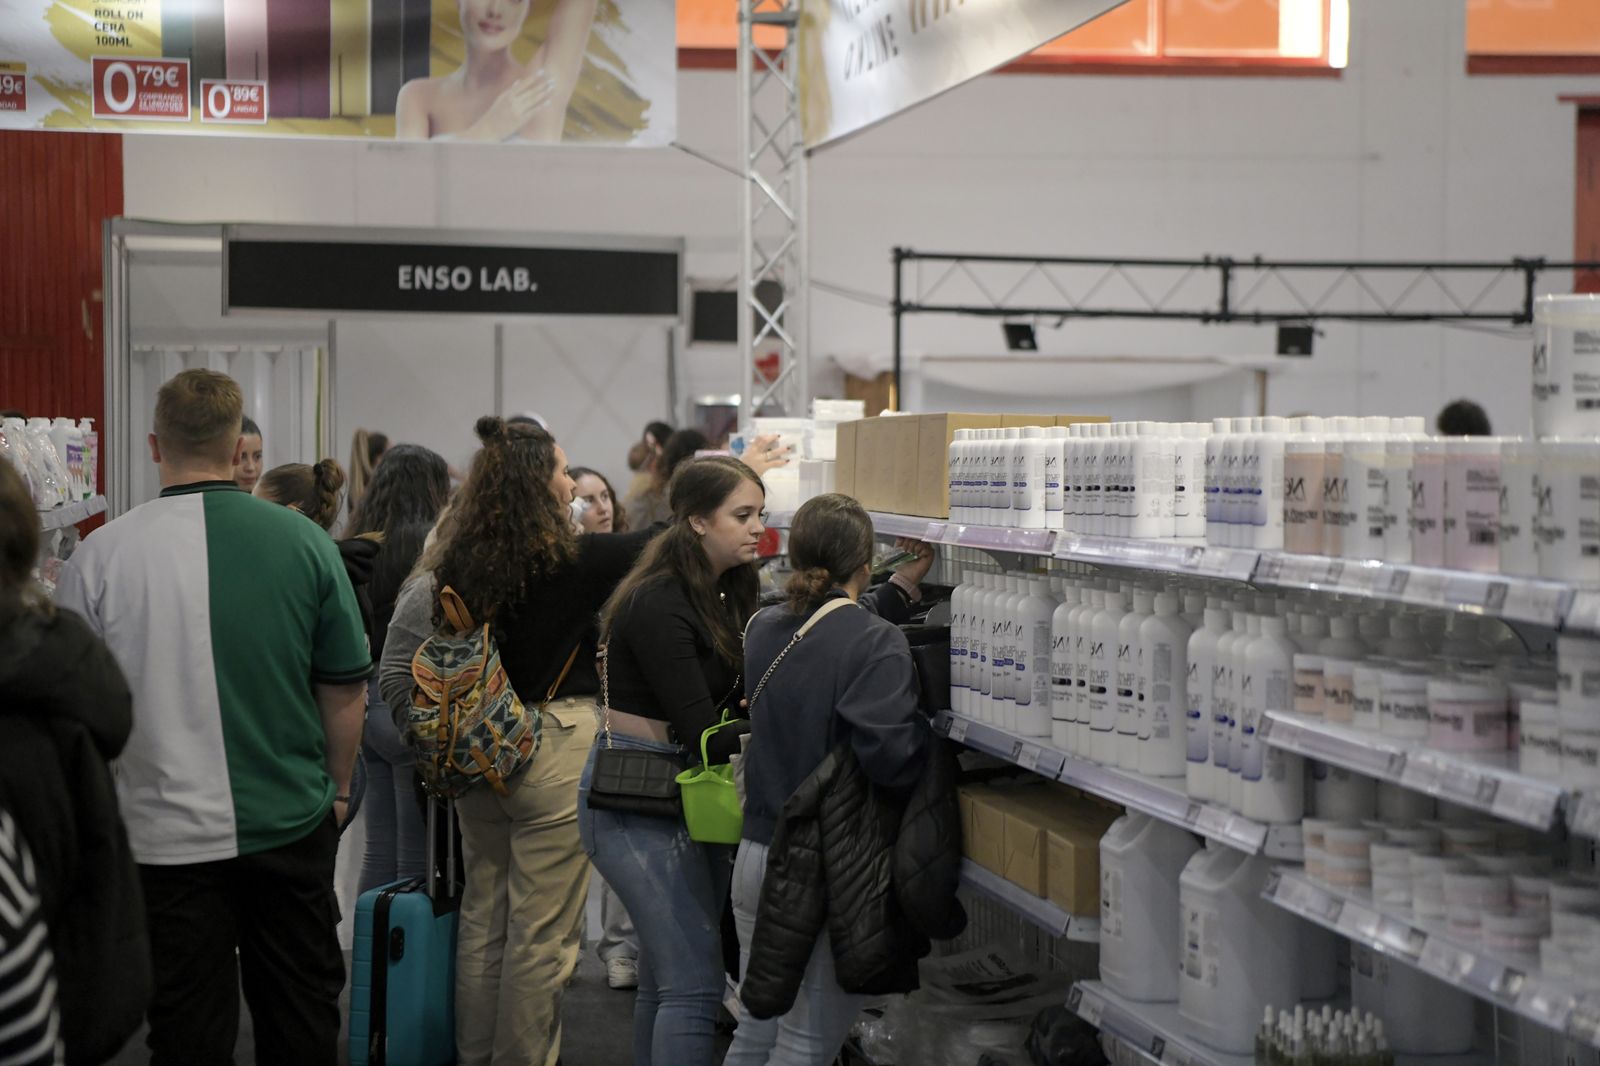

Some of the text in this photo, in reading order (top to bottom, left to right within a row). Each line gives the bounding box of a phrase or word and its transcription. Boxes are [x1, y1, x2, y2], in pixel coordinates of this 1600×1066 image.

[94, 9, 144, 21] ROLL ON
[94, 22, 126, 32] CERA
[95, 35, 133, 48] 100ML
[398, 264, 538, 292] ENSO LAB.
